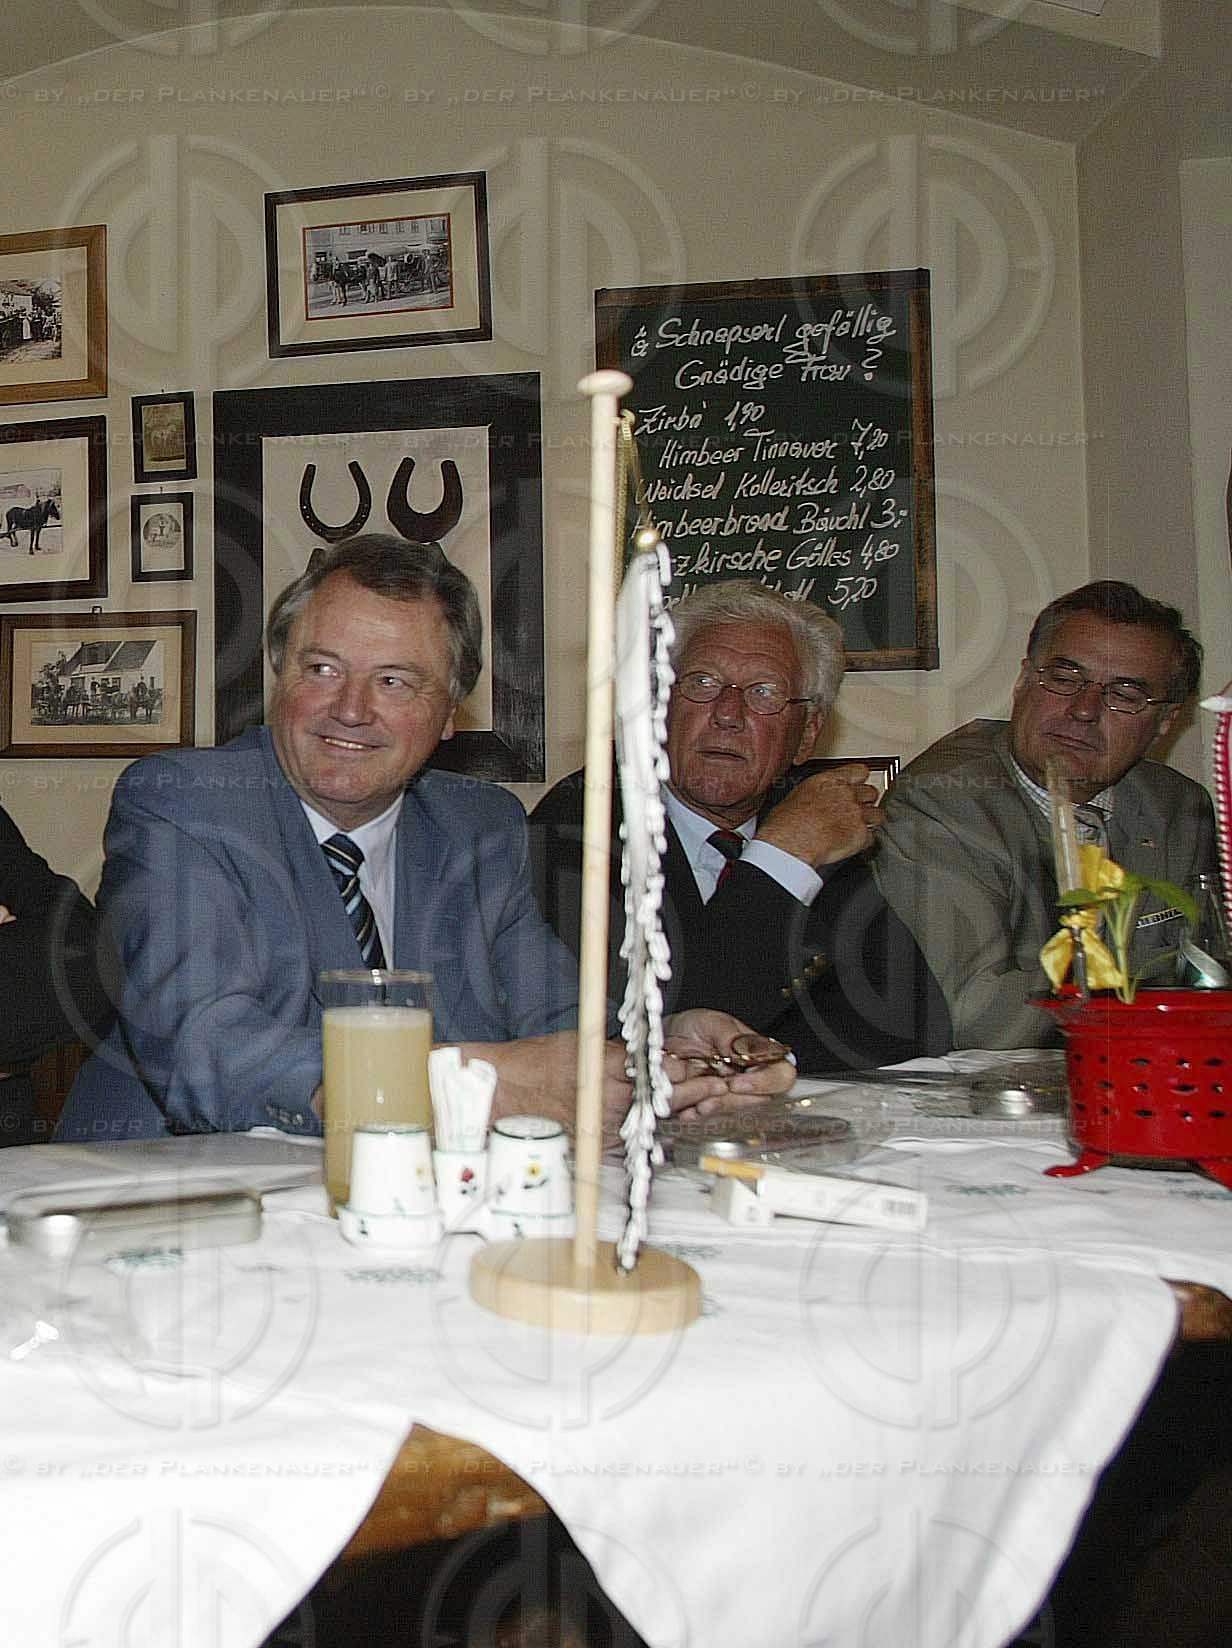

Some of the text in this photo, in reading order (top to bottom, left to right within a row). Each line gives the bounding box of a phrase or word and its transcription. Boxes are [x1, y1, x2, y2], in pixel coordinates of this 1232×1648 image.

[675, 356, 783, 390] Gnädige
[724, 401, 766, 432] 1,90
[658, 437, 745, 468] Himbeer
[849, 465, 895, 498] 2,80
[860, 534, 900, 571] 4,80
[828, 576, 877, 611] 5,20
